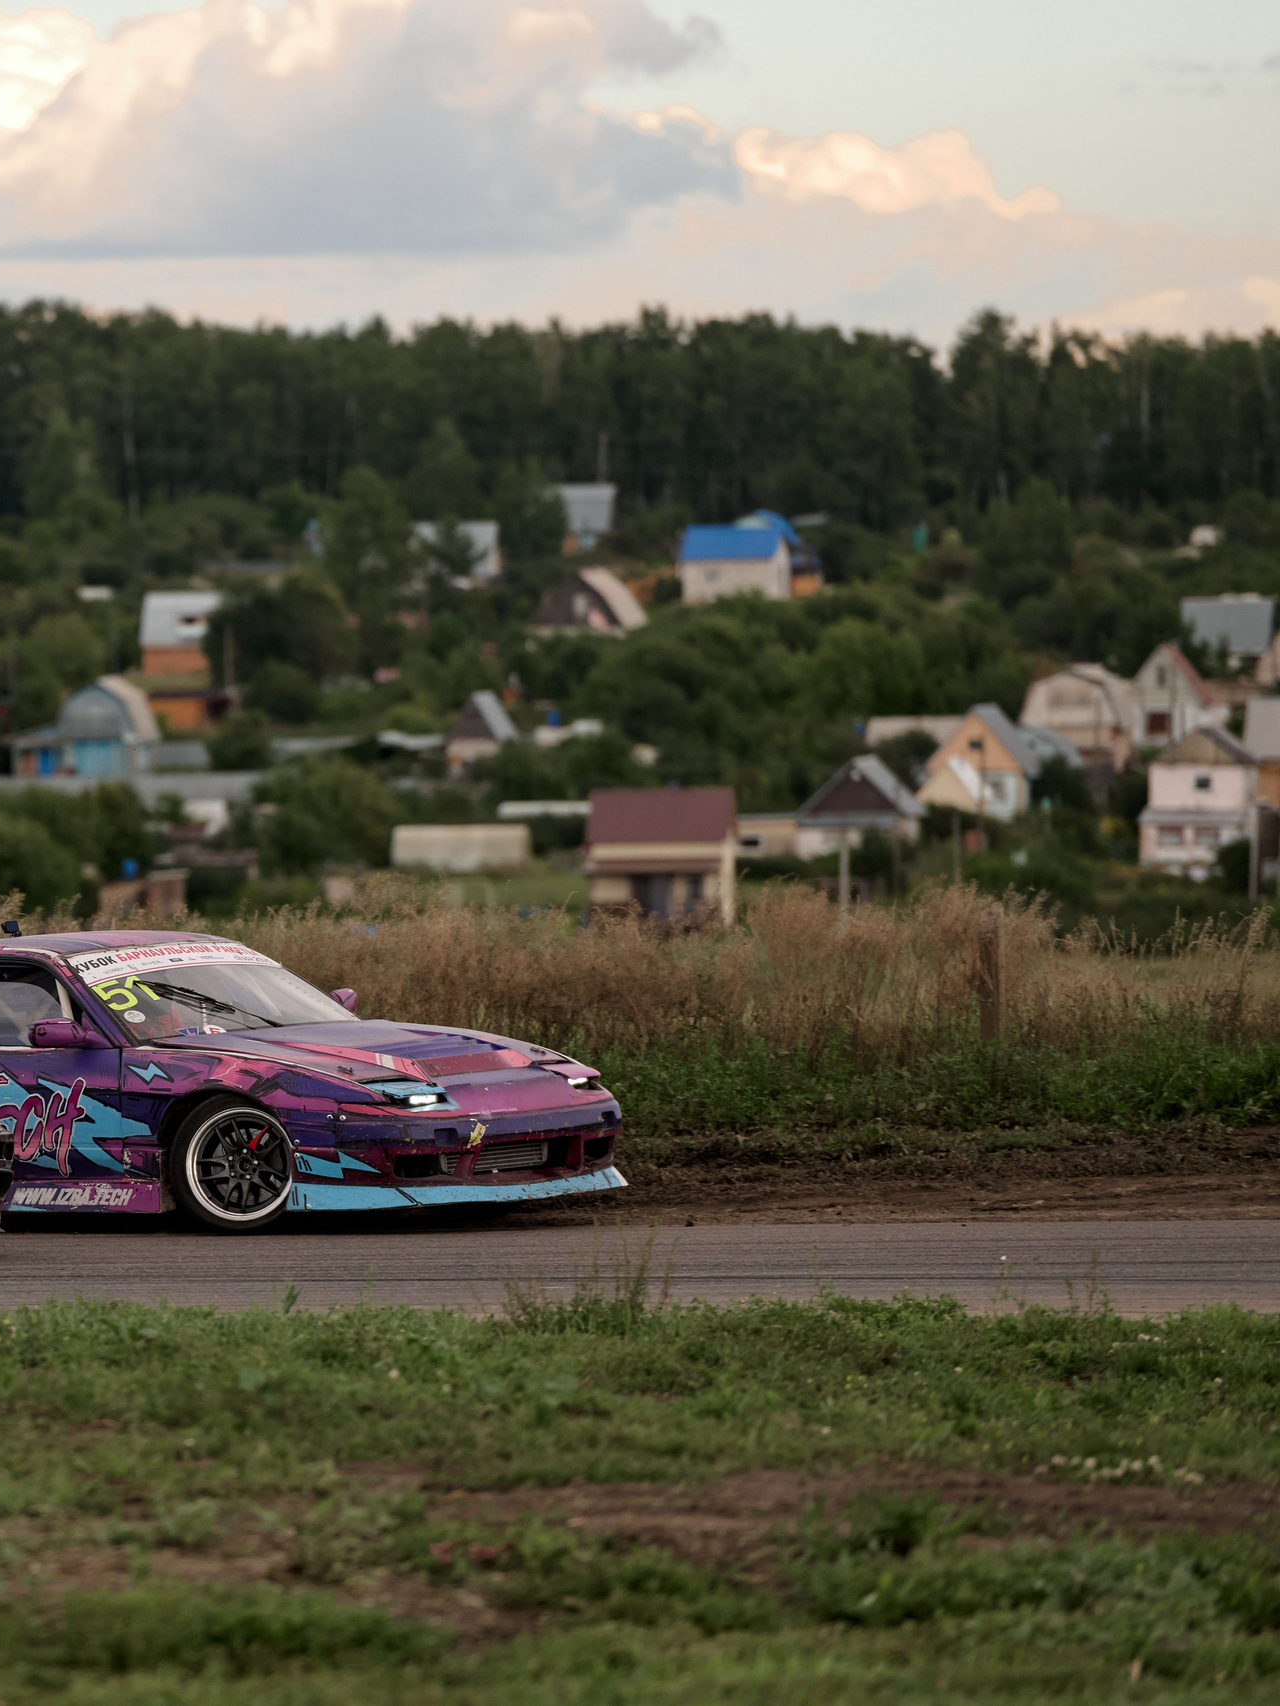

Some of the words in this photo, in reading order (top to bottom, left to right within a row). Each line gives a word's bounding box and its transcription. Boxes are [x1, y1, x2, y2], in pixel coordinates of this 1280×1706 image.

[74, 955, 118, 974] КУБОК
[115, 944, 213, 962] БАРНАУЛЬСКОЙ
[91, 976, 160, 1010] 51
[11, 1186, 134, 1206] WWW.IZBA.TECH
